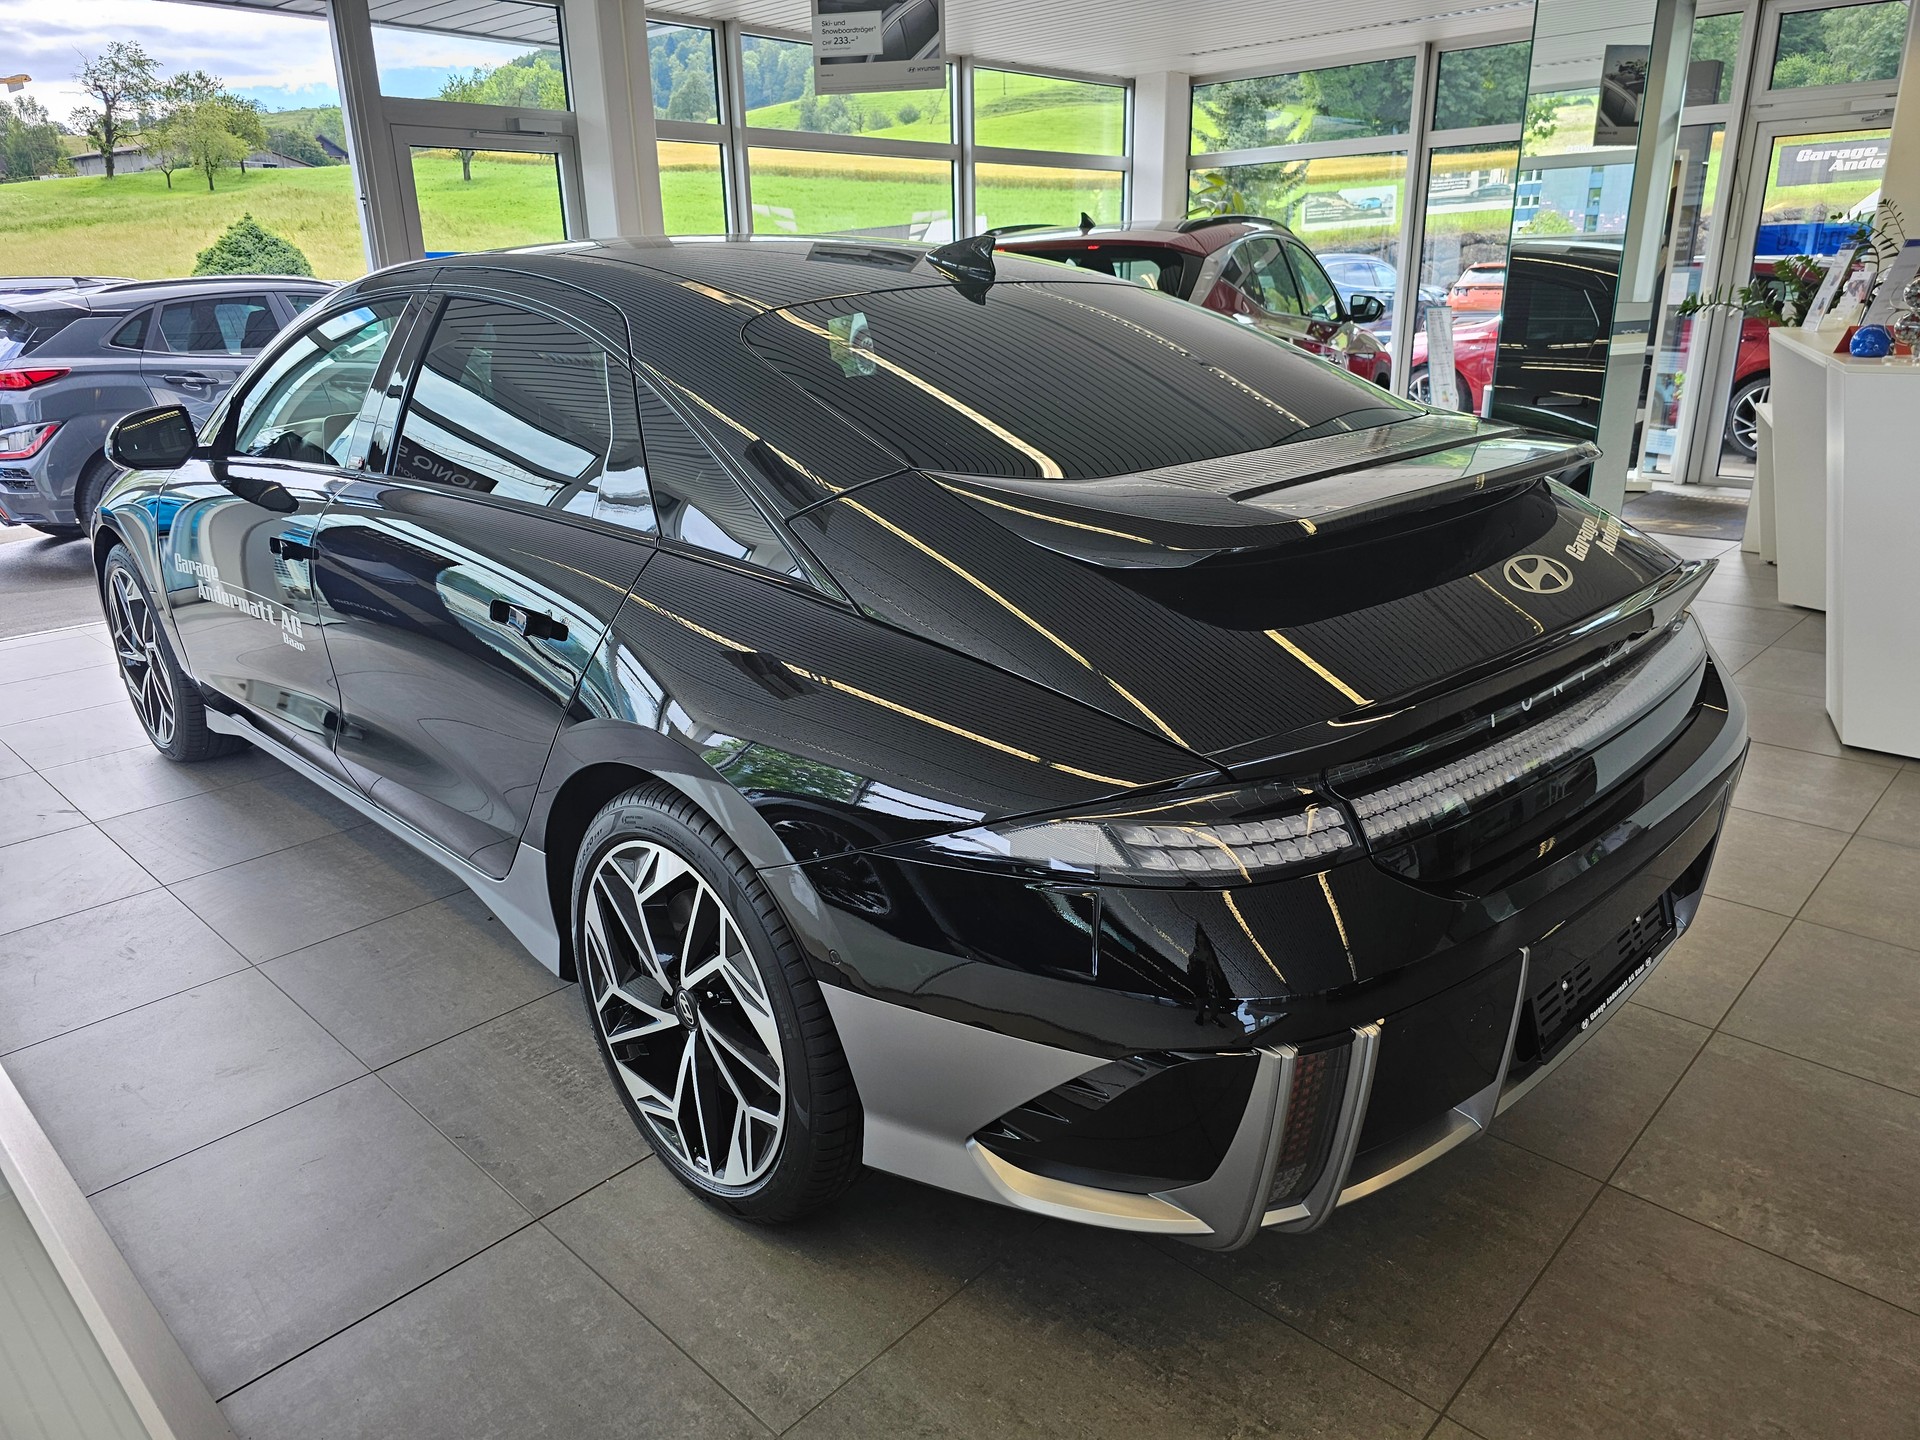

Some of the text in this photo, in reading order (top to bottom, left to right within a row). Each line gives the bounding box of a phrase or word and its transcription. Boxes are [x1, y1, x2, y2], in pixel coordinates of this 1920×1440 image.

[1796, 146, 1879, 162] Garage
[1565, 517, 1599, 562] Garage
[174, 553, 220, 582] Garage
[197, 580, 303, 639] Andermatt AG
[282, 632, 306, 651] Baar
[1590, 1002, 1606, 1020] Garage
[1606, 980, 1628, 1005] Andermatt
